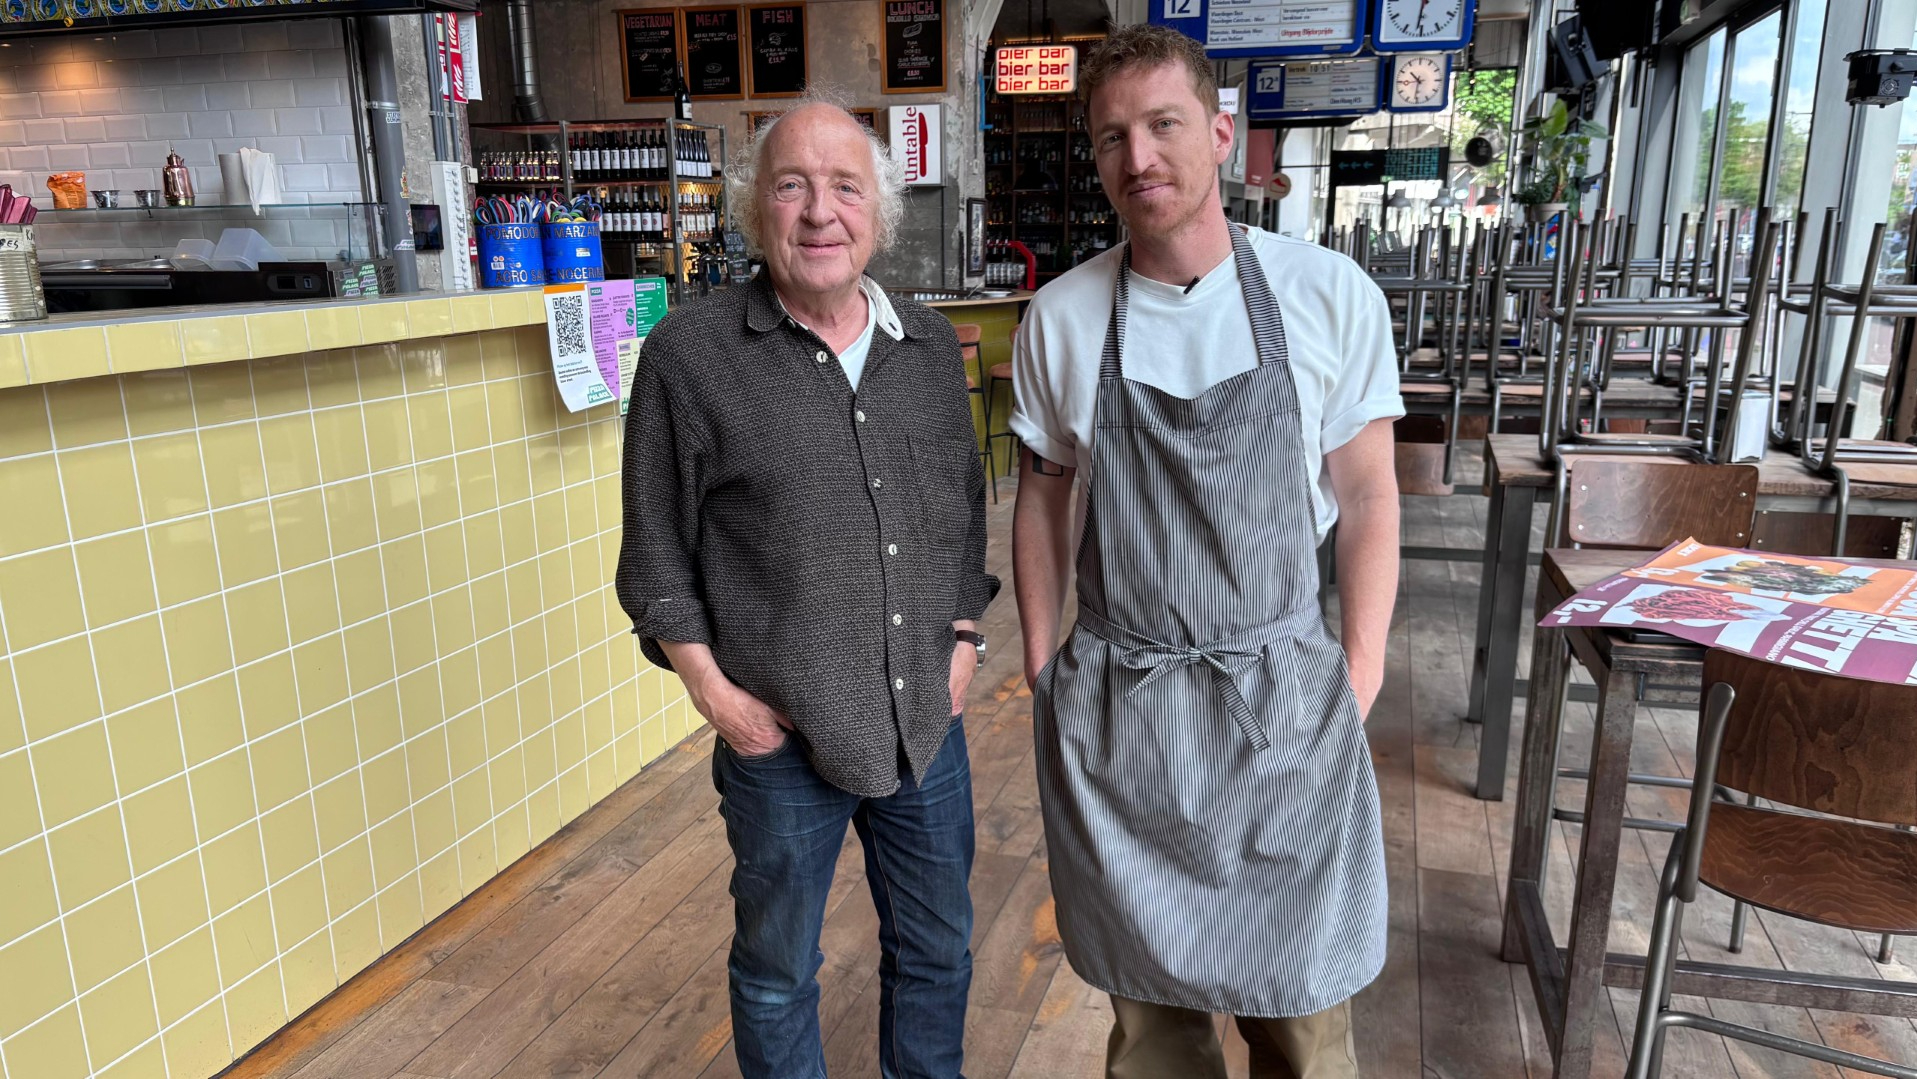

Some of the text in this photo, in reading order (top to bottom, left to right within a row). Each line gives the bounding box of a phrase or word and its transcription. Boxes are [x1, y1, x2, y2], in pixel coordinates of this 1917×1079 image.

[889, 1, 934, 16] LUNCH
[624, 15, 672, 29] VEGETARIAN
[695, 13, 727, 27] MEAT
[762, 9, 793, 24] FISH
[998, 60, 1070, 76] bier bar
[998, 77, 1069, 92] bier bar
[496, 270, 528, 284] AGRO
